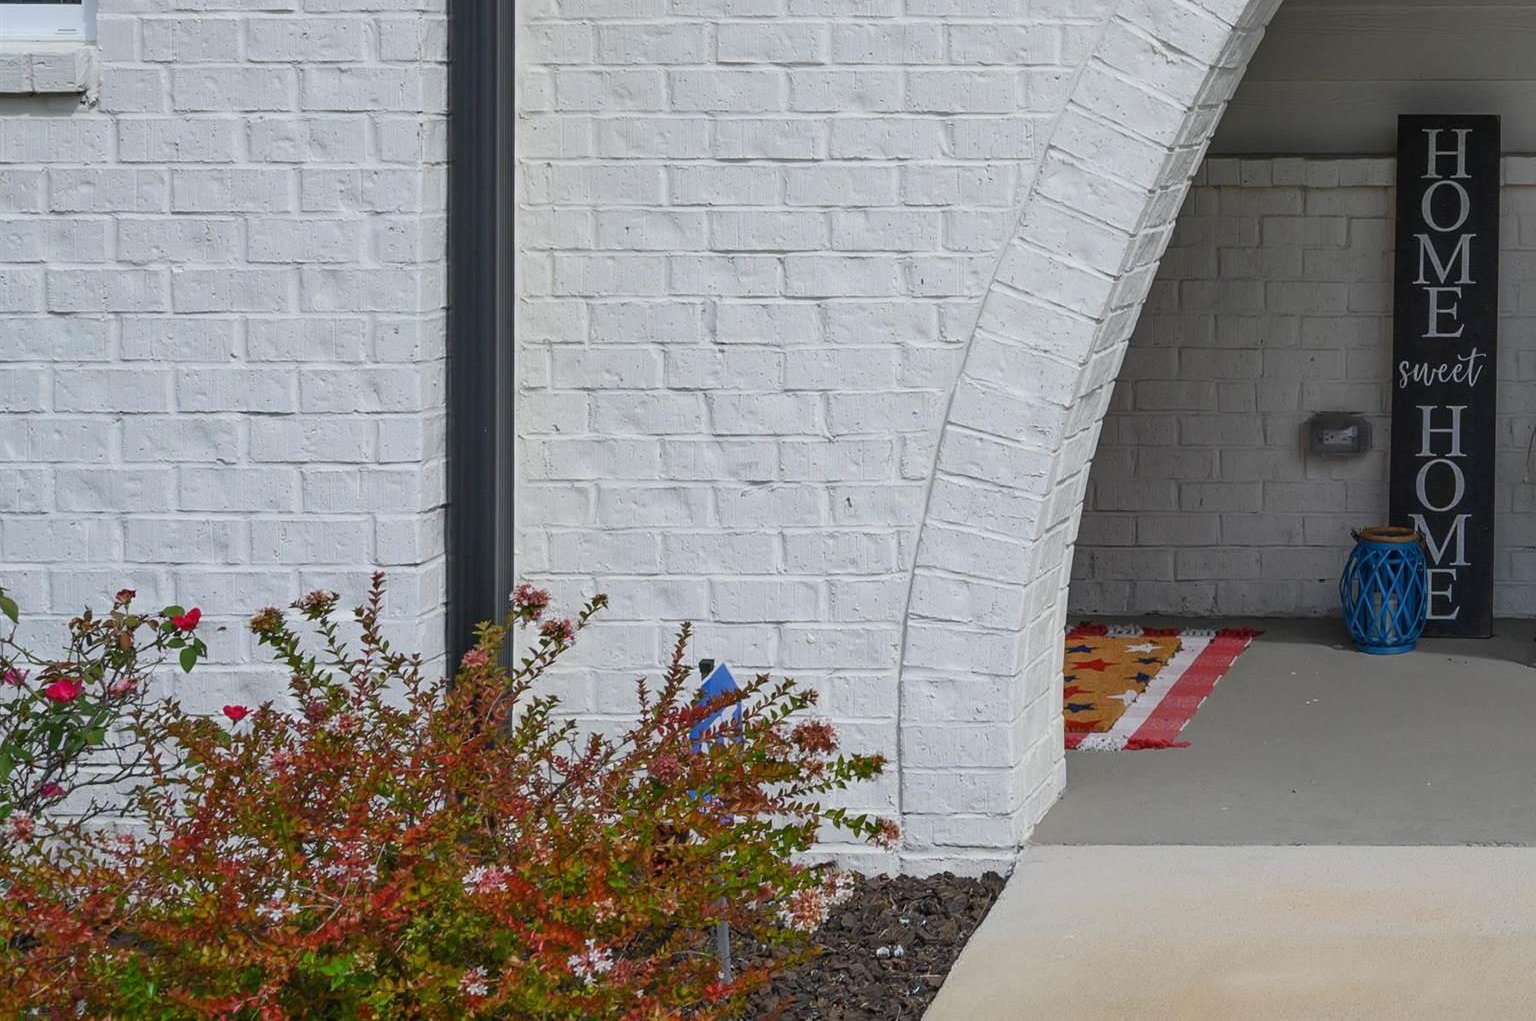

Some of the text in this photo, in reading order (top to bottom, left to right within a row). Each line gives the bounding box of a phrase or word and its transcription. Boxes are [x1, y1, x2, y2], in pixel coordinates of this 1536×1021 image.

[1412, 128, 1477, 338] HOME
[1399, 347, 1487, 389] sweet
[1408, 405, 1472, 620] HOME
